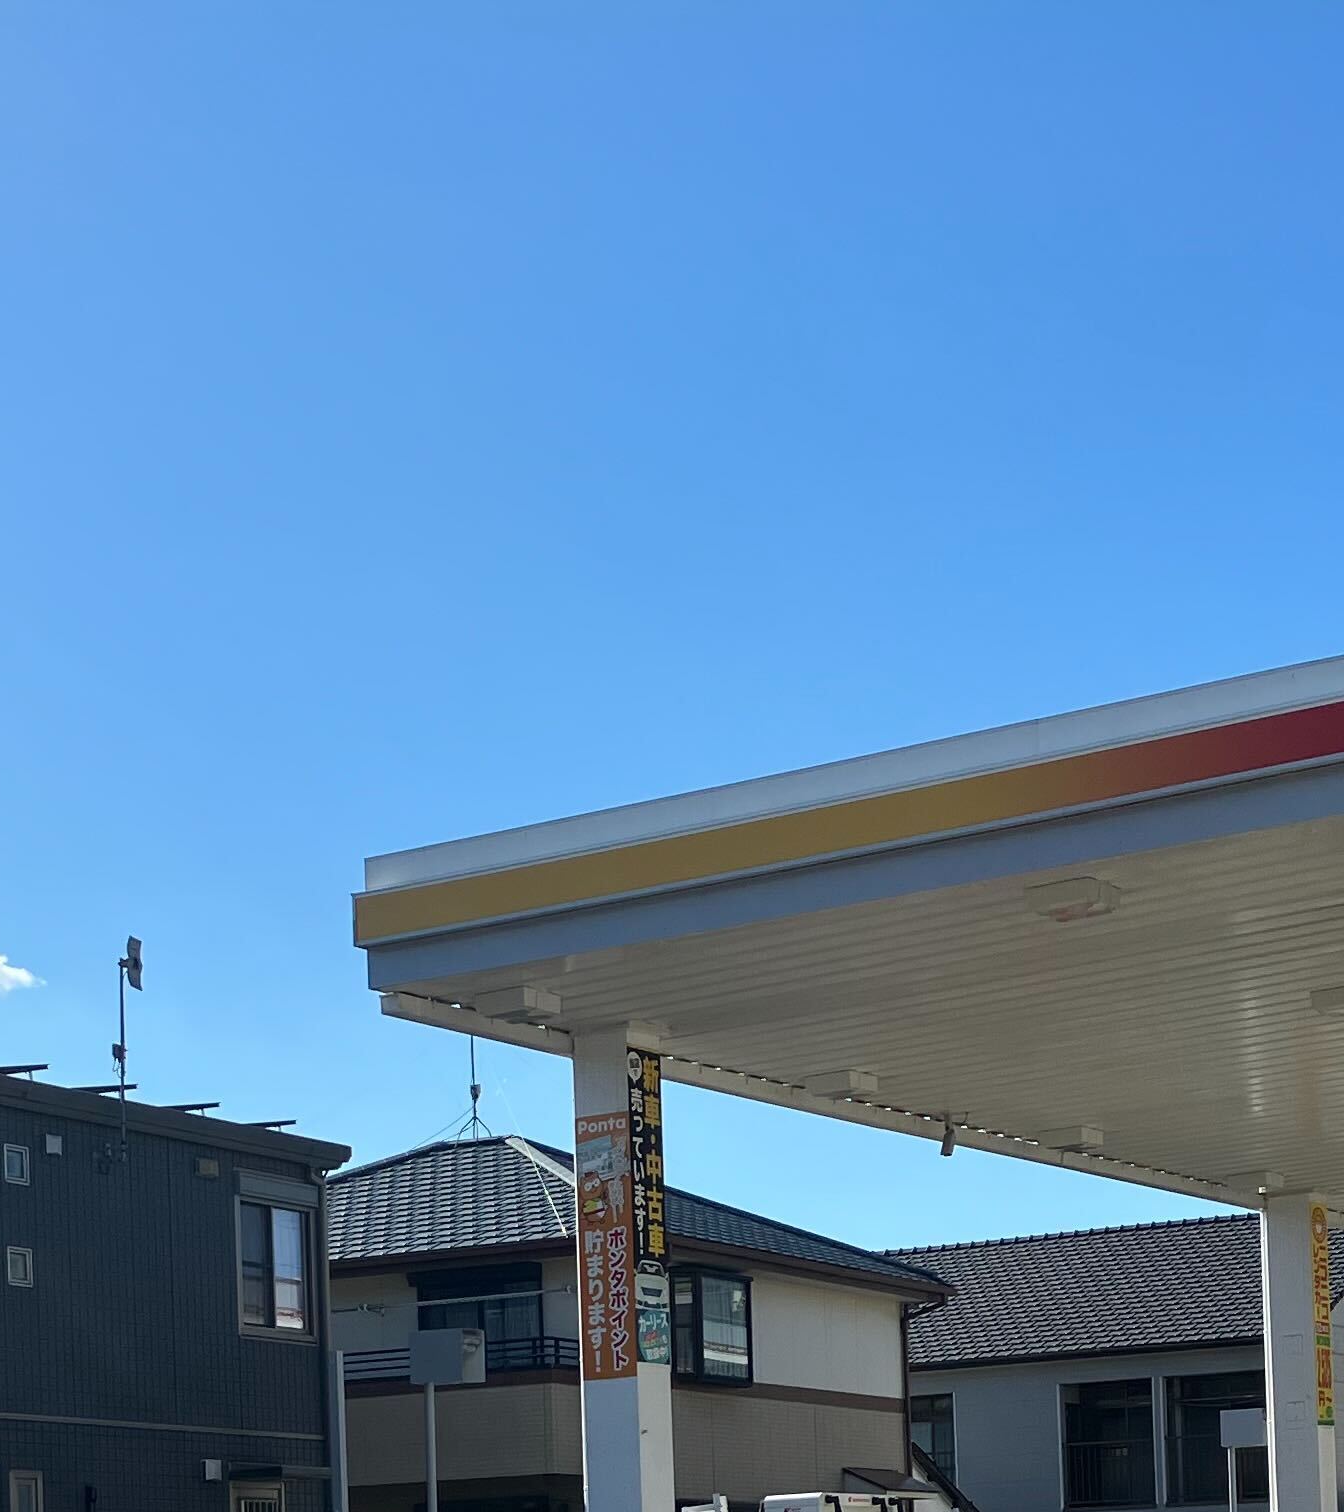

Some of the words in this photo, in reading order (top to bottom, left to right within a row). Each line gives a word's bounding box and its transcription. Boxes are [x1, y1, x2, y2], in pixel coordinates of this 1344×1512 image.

[578, 1118, 626, 1135] Ponta
[642, 1057, 665, 1259] 新車・中古車
[584, 1230, 606, 1373] 貯まります!
[607, 1226, 630, 1370] ポンタポイント
